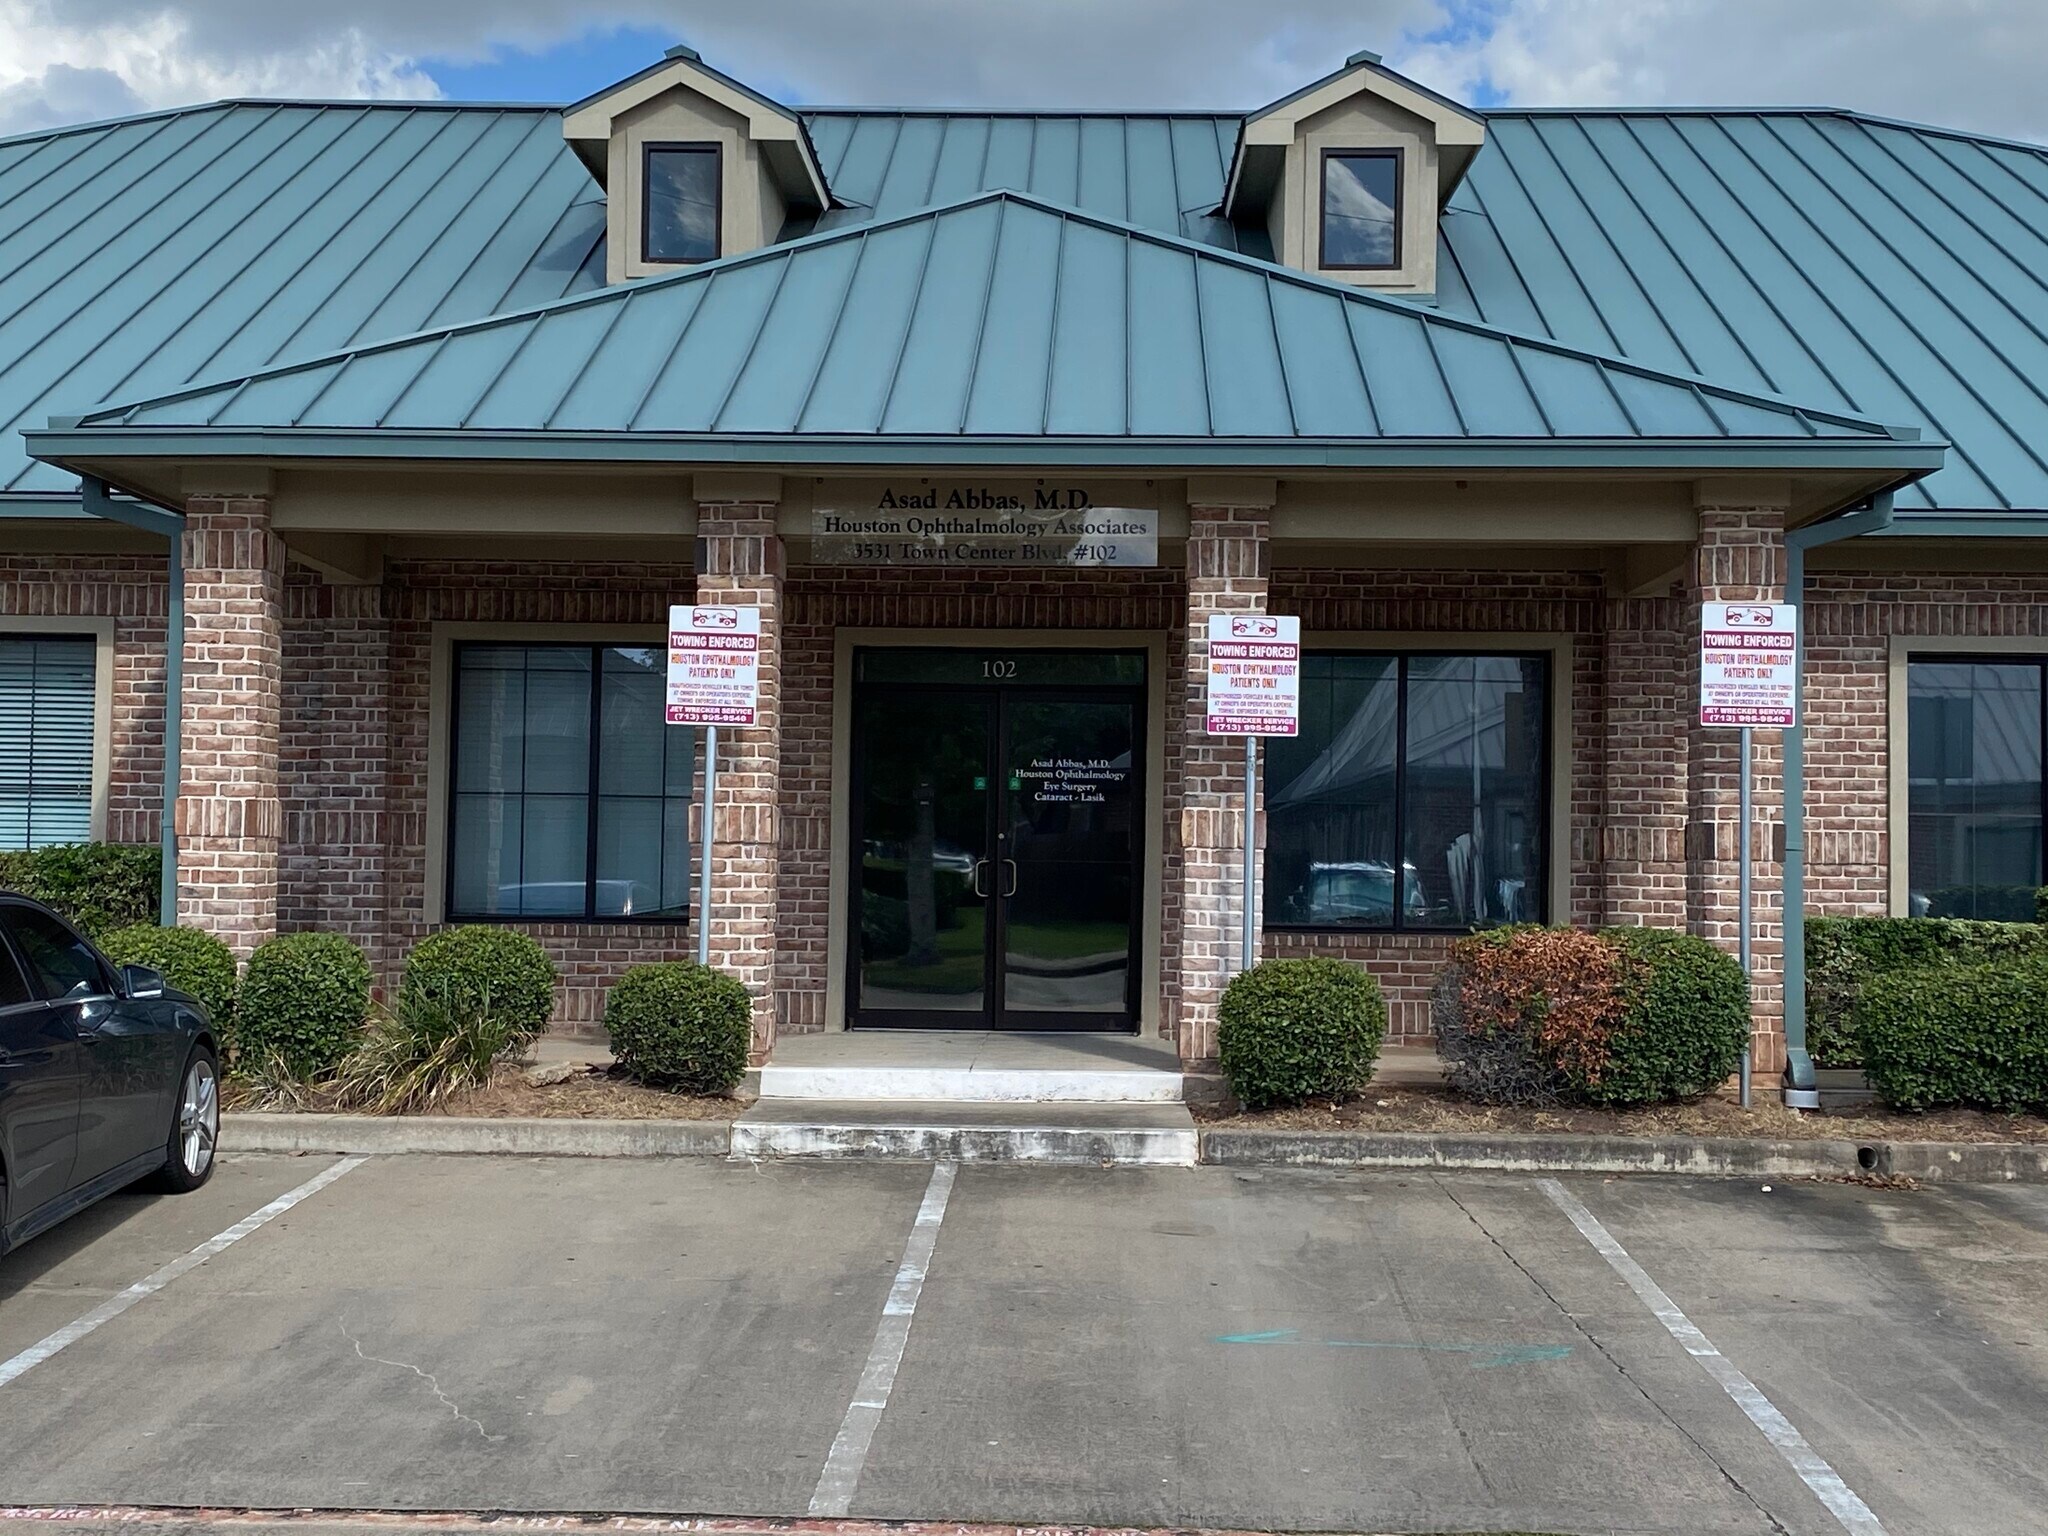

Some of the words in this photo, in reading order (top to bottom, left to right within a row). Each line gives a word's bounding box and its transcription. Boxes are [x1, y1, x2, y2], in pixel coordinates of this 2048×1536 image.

[878, 488, 937, 509] Asad
[945, 488, 1025, 512] Abbas,
[1034, 489, 1094, 510] M.D.
[824, 517, 901, 533] Houston
[907, 517, 1048, 537] Ophthalmology
[1053, 519, 1147, 535] Associates
[854, 544, 891, 559] 3531
[900, 543, 949, 560] Town
[955, 544, 1016, 560] Center
[1022, 544, 1068, 560] Blvd.
[1074, 544, 1117, 561] #102
[672, 634, 707, 647] TOWING
[709, 636, 755, 648] ENFORCED
[1705, 634, 1741, 646] TOWING
[1743, 635, 1792, 647] ENFORCED
[1212, 645, 1247, 657] TOWING
[1249, 646, 1295, 658] ENFORCED
[671, 653, 700, 664] HOUSTON
[702, 654, 755, 666] OPHTHALMOLOGY
[1705, 653, 1735, 664] HOUSTON
[1737, 654, 1792, 666] OPHTHALMOLOGY
[689, 667, 718, 678] PATIENTS
[721, 668, 736, 679] ONLY
[983, 661, 1017, 678] 102
[1212, 663, 1240, 674] HOUSTON
[1243, 664, 1296, 676] OPHTHALMOLOGY
[1724, 667, 1755, 678] PATIENTS
[1757, 668, 1773, 678] ONLY
[1230, 677, 1260, 688] PATIENTS
[1262, 678, 1278, 688] ONLY
[675, 714, 700, 722] (713)
[1216, 724, 1241, 732] (713)
[1031, 759, 1053, 768] Asad
[1055, 759, 1086, 769] Abbas,
[1088, 760, 1111, 768] M.D.
[1016, 769, 1053, 778] Houston
[1056, 770, 1125, 780] Ophthalmology
[1044, 781, 1060, 791] Eye
[1062, 782, 1097, 792] Surgery
[1035, 792, 1072, 801] Cataract
[1081, 793, 1105, 801] Lasik
